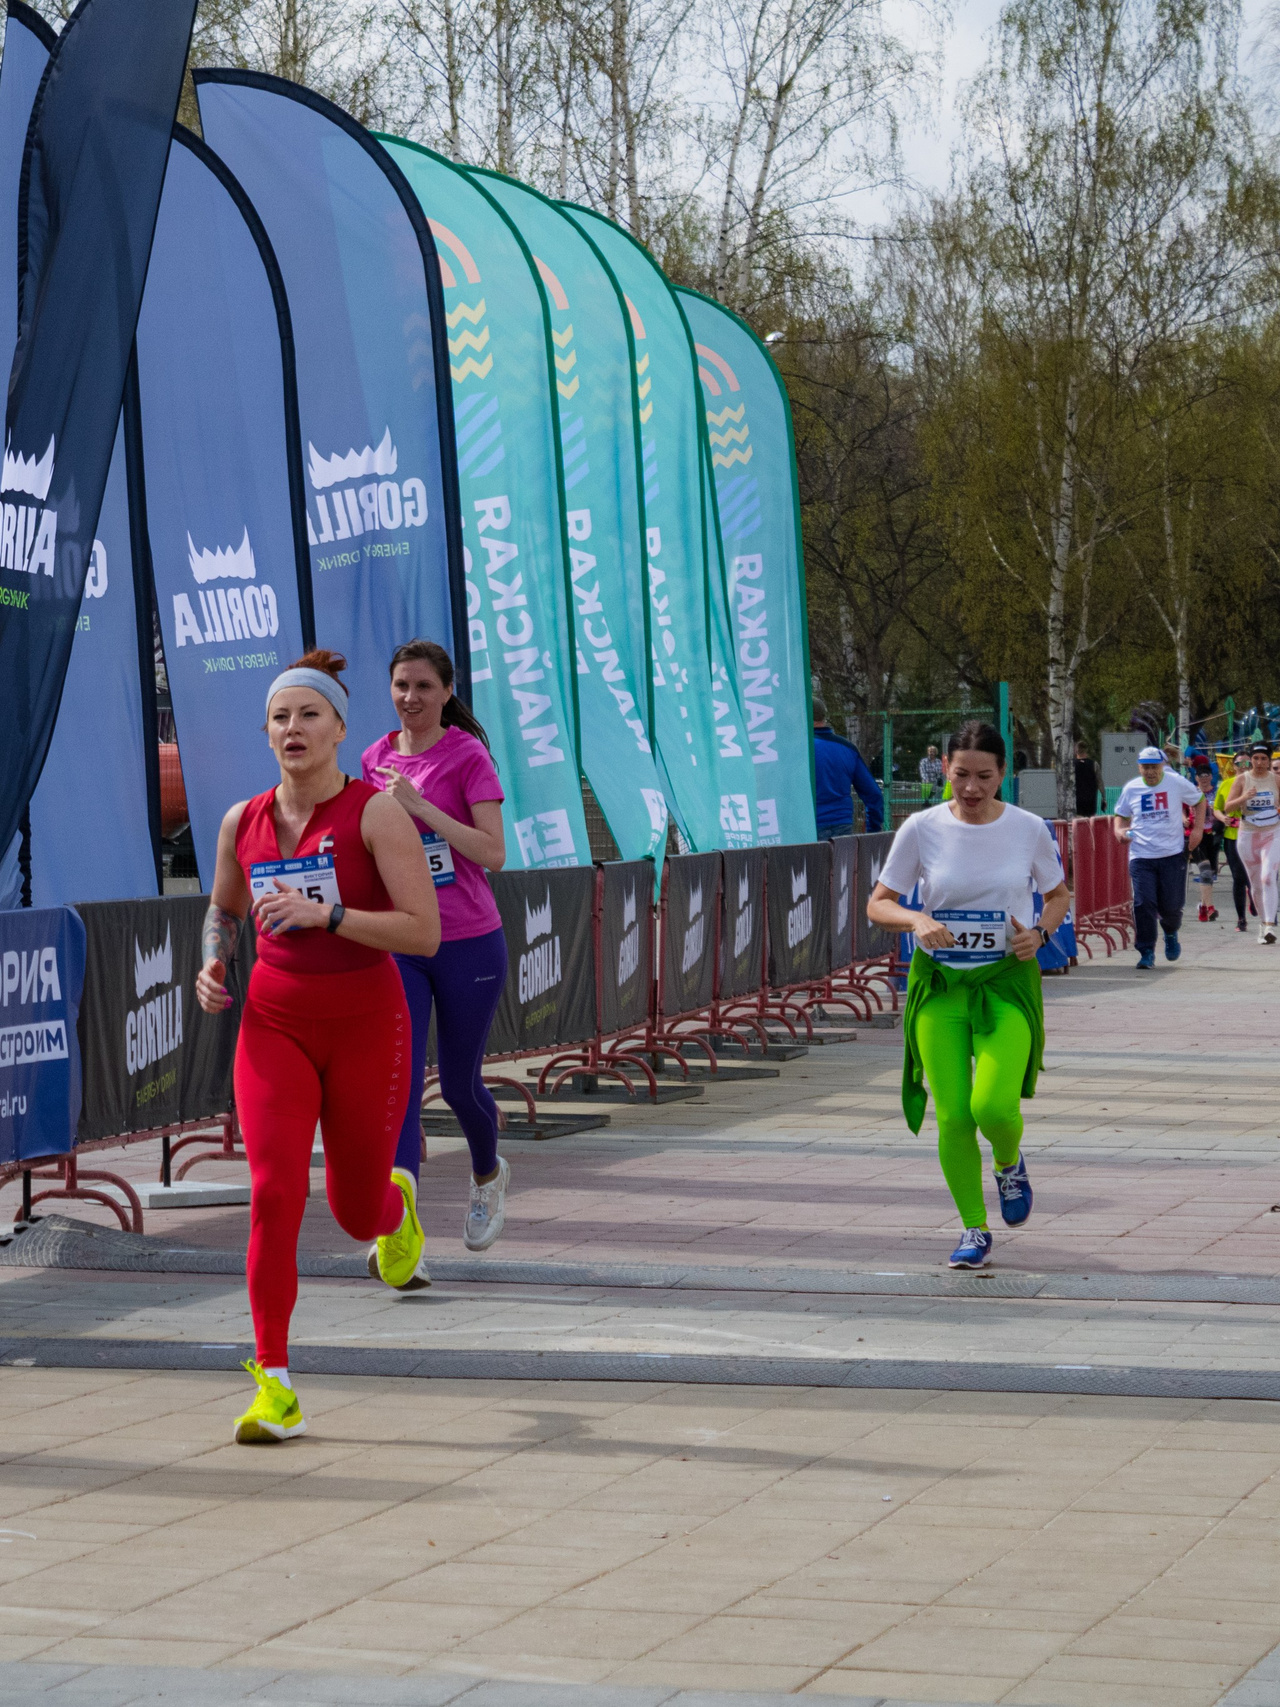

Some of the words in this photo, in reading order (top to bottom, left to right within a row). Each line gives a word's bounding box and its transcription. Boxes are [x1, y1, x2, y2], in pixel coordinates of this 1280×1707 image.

[519, 936, 562, 1005] GORILLA
[0, 1026, 65, 1065] строим
[125, 984, 184, 1076] GORILLA
